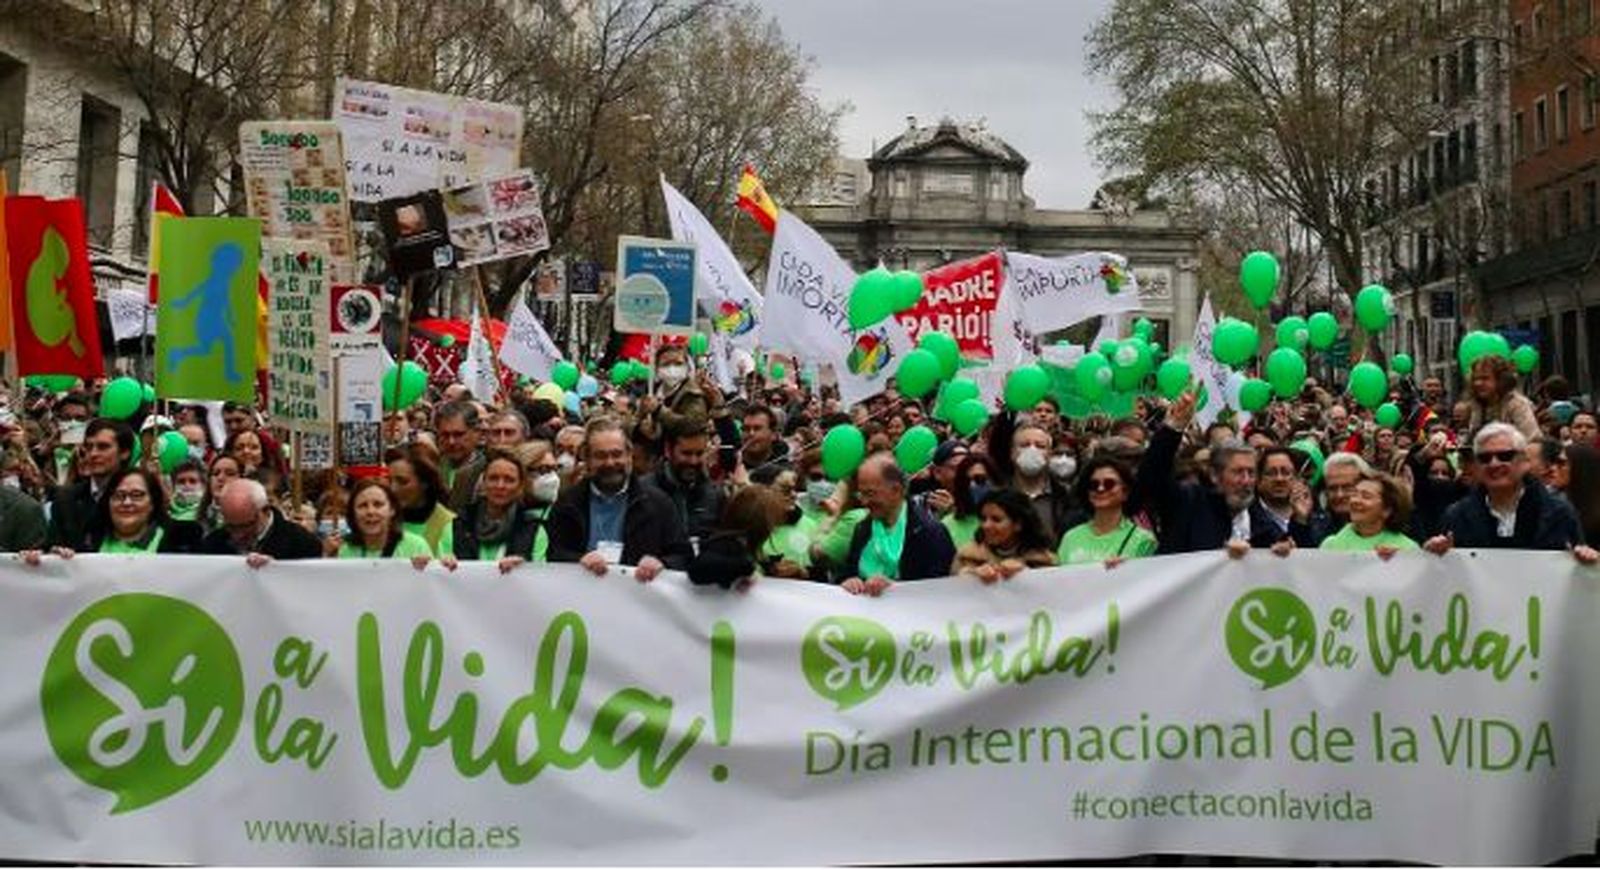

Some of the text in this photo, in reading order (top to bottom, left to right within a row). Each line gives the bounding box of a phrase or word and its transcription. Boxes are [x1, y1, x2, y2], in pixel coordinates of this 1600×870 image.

[818, 599, 1120, 690] Sí a la Vida!
[1240, 593, 1541, 682] Sí a la Vida!
[75, 610, 736, 791] Sí a la Vida!
[804, 708, 1557, 776] Día Internacional de la VIDA
[244, 818, 521, 851] www.sialavida.es
[1071, 789, 1374, 823] #conectaconlavida
